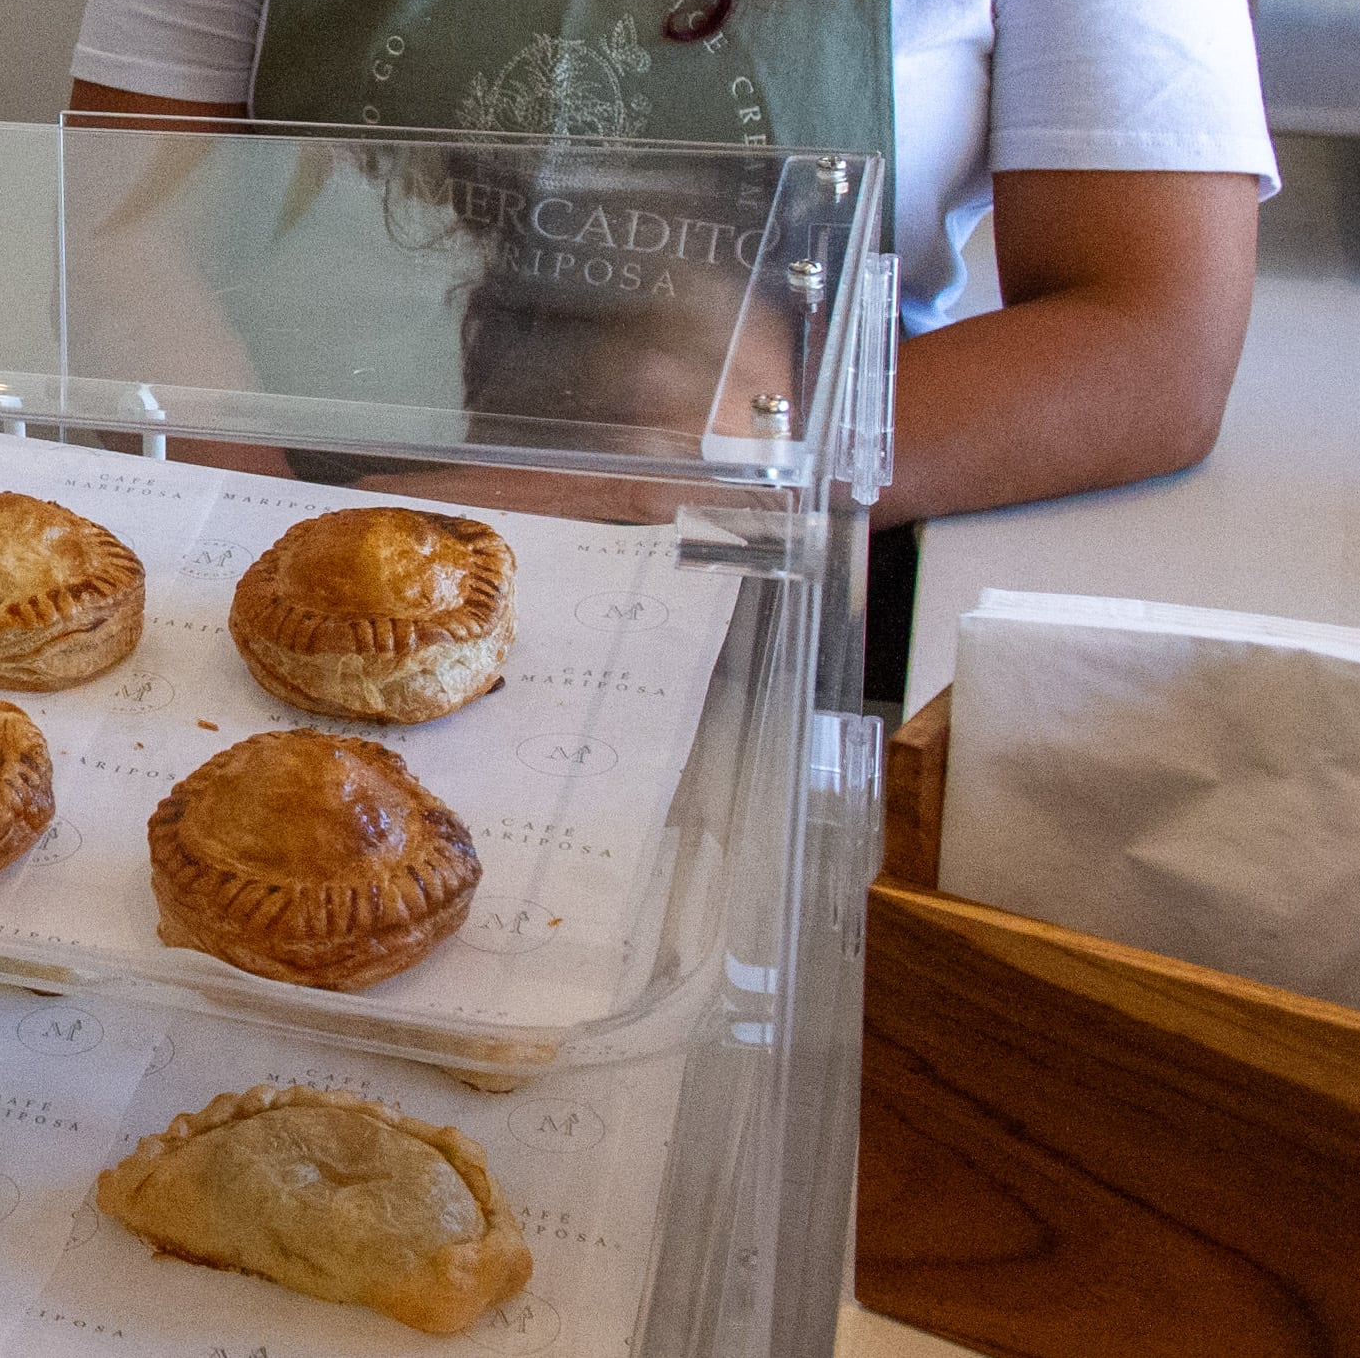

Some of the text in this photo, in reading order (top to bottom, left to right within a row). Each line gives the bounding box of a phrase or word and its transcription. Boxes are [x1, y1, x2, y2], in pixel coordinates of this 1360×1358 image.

[371, 34, 406, 82] GO
[64, 478, 183, 500] MARIPOSA
[223, 492, 332, 512] MARIPOS
[520, 673, 666, 698] MARIPOSA
[77, 755, 178, 782] ARIPOS
[481, 826, 612, 859] ARIPOSA
